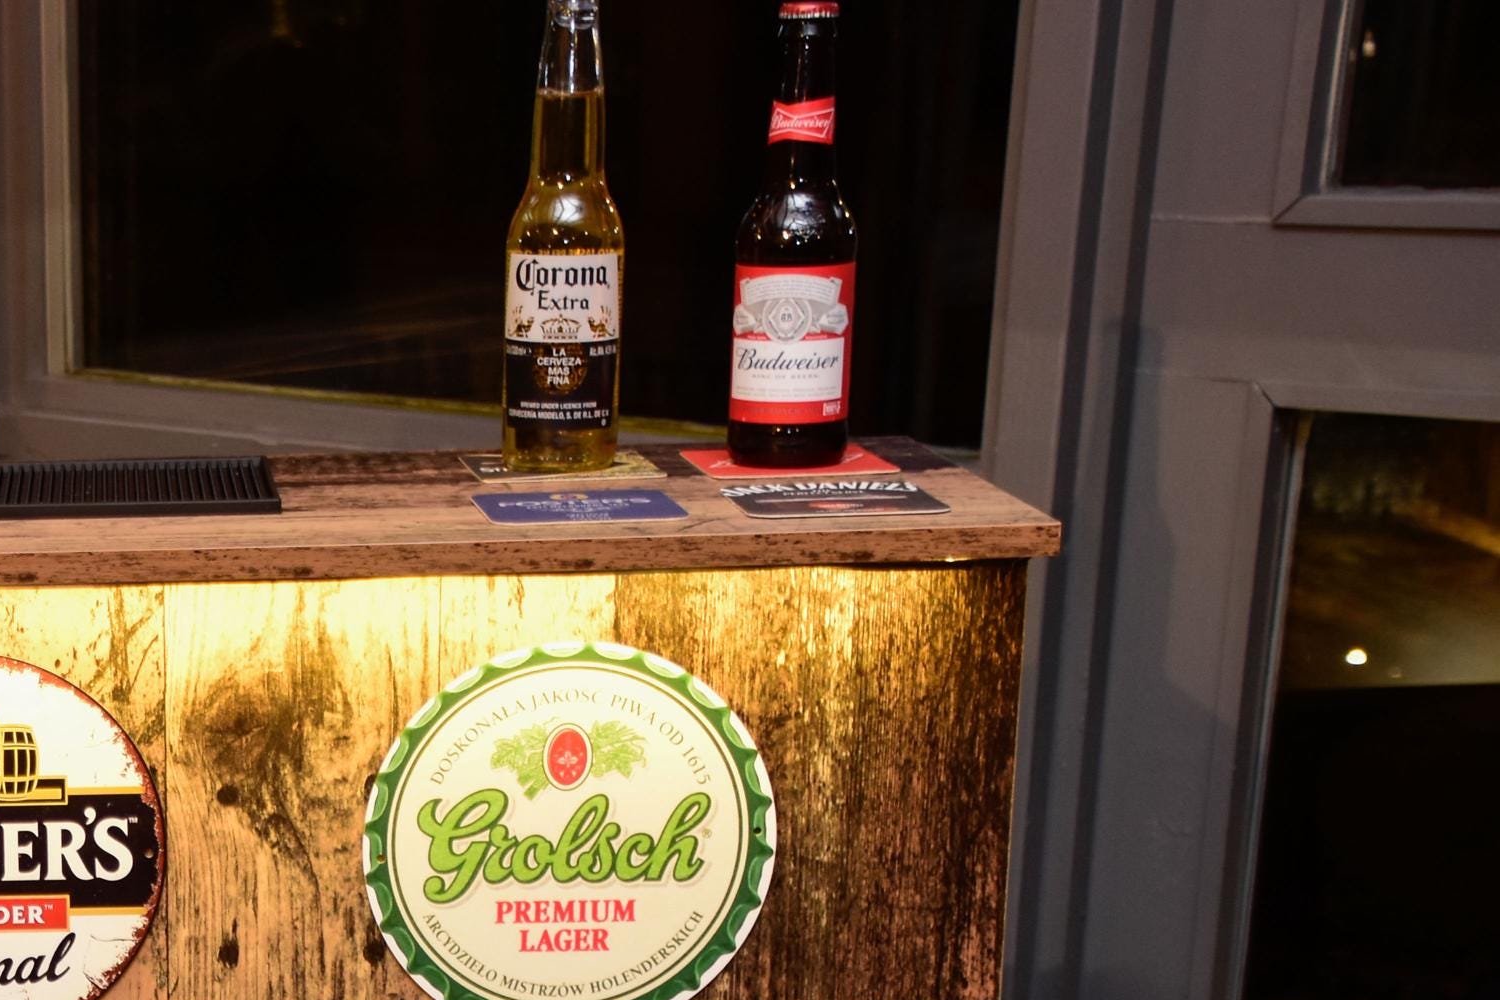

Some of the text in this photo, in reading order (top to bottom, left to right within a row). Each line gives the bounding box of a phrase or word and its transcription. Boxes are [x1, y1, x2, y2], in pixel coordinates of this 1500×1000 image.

[772, 114, 829, 129] Budweiser
[516, 259, 610, 296] Corona
[538, 290, 589, 311] Extra
[537, 357, 582, 366] CERVEZA
[552, 347, 567, 357] LA
[736, 348, 839, 370] Budweiser
[547, 366, 570, 376] MAS
[547, 376, 570, 385] FINA
[720, 484, 796, 497] JACK
[611, 694, 656, 726] PIWA
[660, 721, 684, 745] OD
[682, 746, 712, 785] 1615
[416, 788, 712, 905] Grolsch
[494, 899, 637, 925] PREMIUM
[518, 928, 610, 953] LAGER
[500, 975, 586, 998] MISTRZÓW
[591, 910, 705, 995] HOLENDERSKICH
